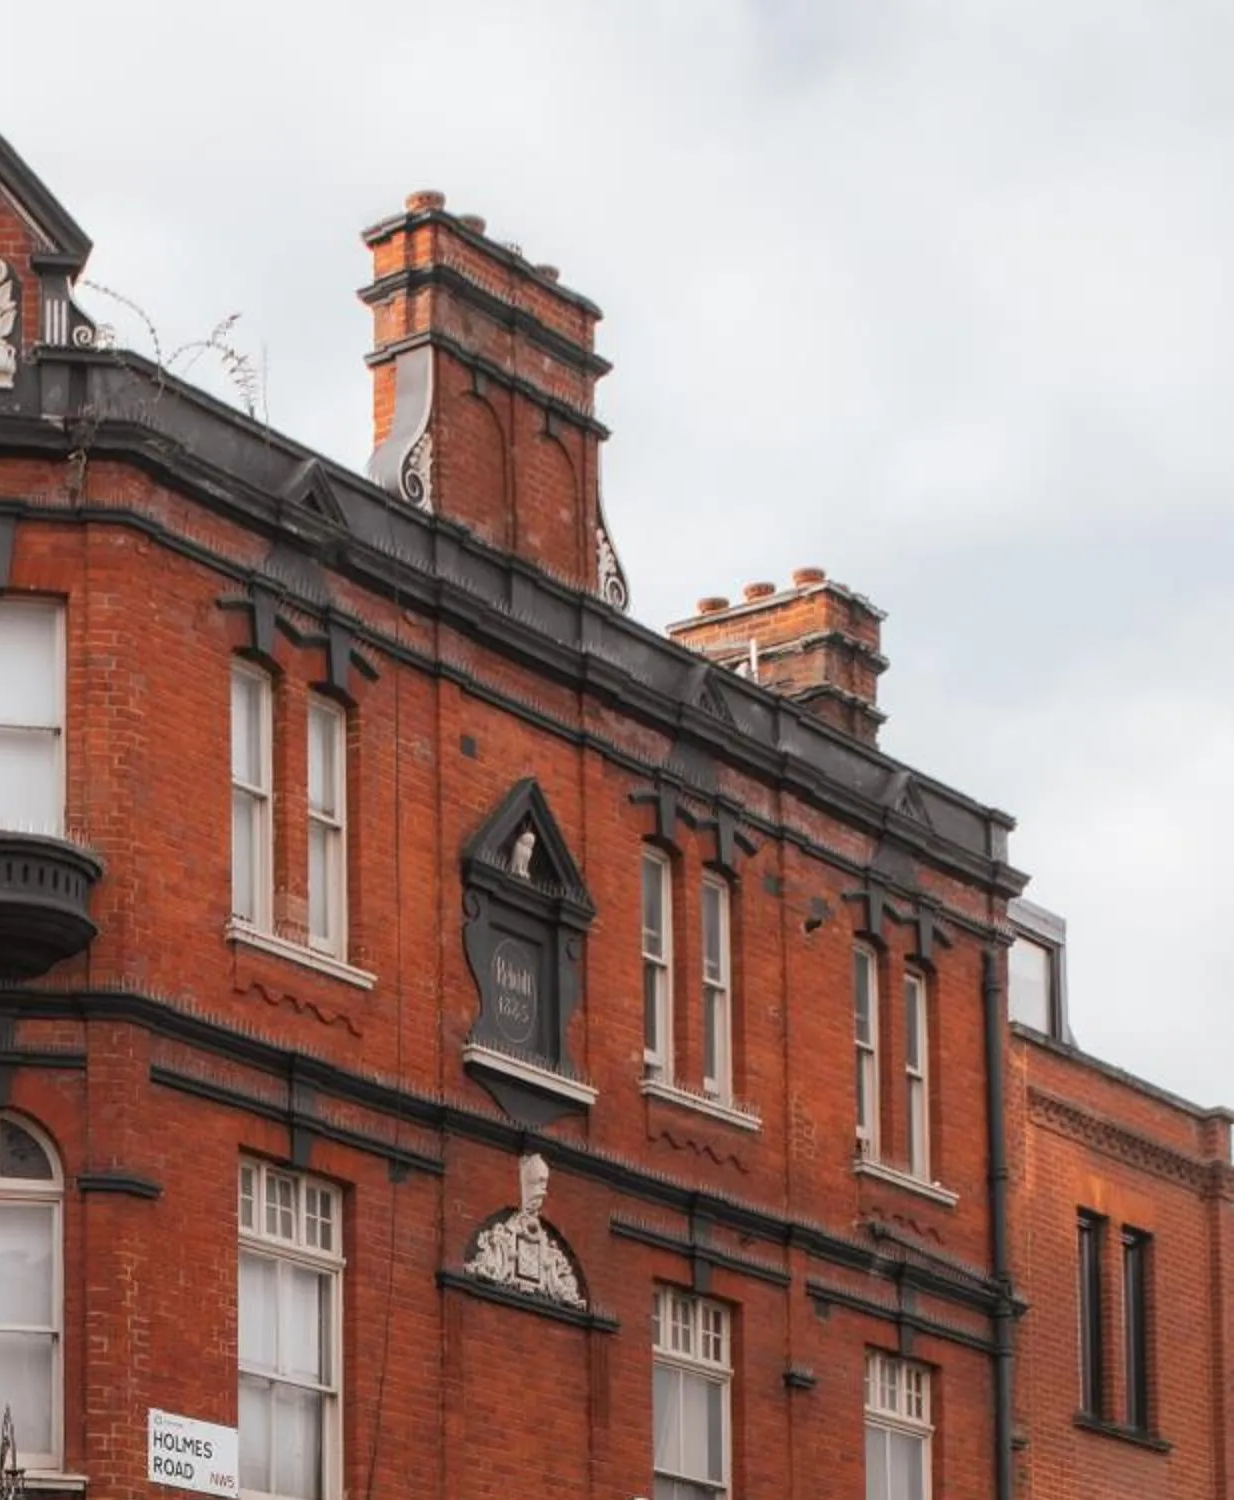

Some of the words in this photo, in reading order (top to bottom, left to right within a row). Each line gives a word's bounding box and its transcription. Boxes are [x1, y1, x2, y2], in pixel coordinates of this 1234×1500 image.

[153, 1430, 213, 1459] HOLMES
[153, 1456, 195, 1480] ROAD
[209, 1472, 235, 1488] NW5
